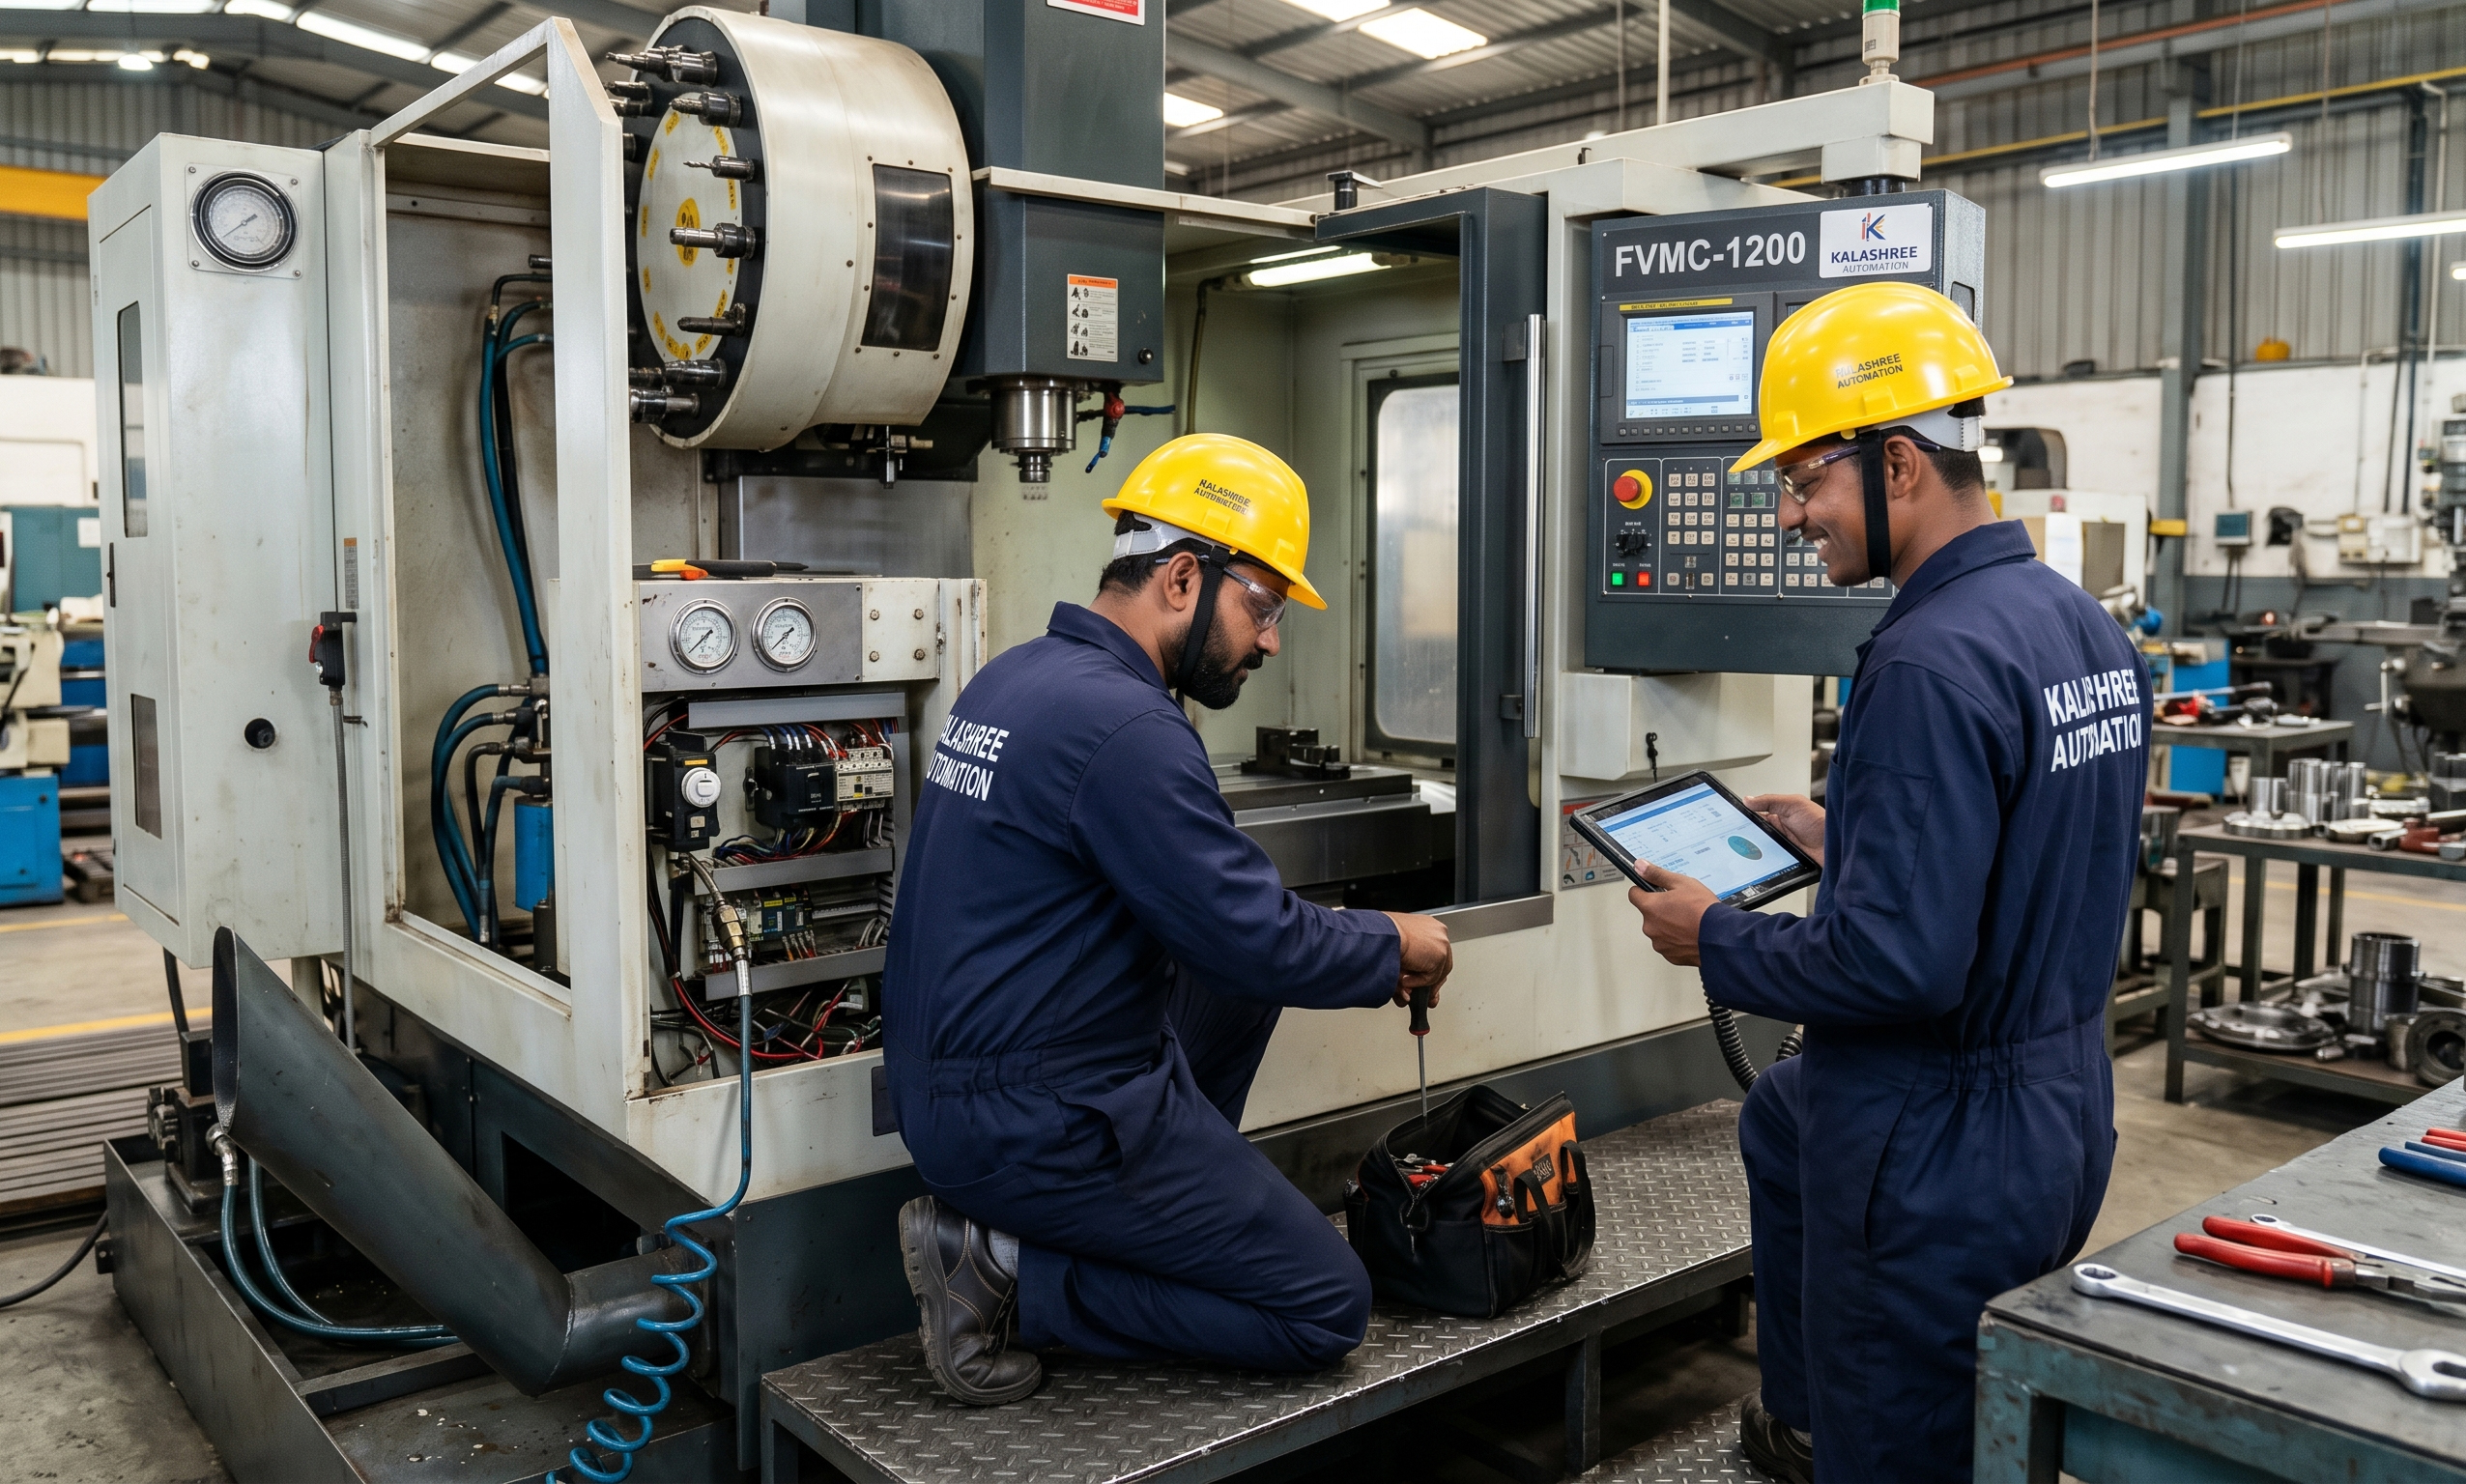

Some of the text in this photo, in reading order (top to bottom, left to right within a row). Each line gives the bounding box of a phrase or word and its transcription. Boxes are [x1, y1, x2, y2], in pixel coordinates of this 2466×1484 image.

[1615, 231, 1806, 277] FVMC-1200
[1831, 246, 1918, 264] KALASHREE
[1842, 261, 1909, 273] AUTOMATION
[1837, 363, 1904, 389] AUTOMATION
[938, 714, 1010, 763] ALASHREE
[926, 749, 994, 802] UTOMATION
